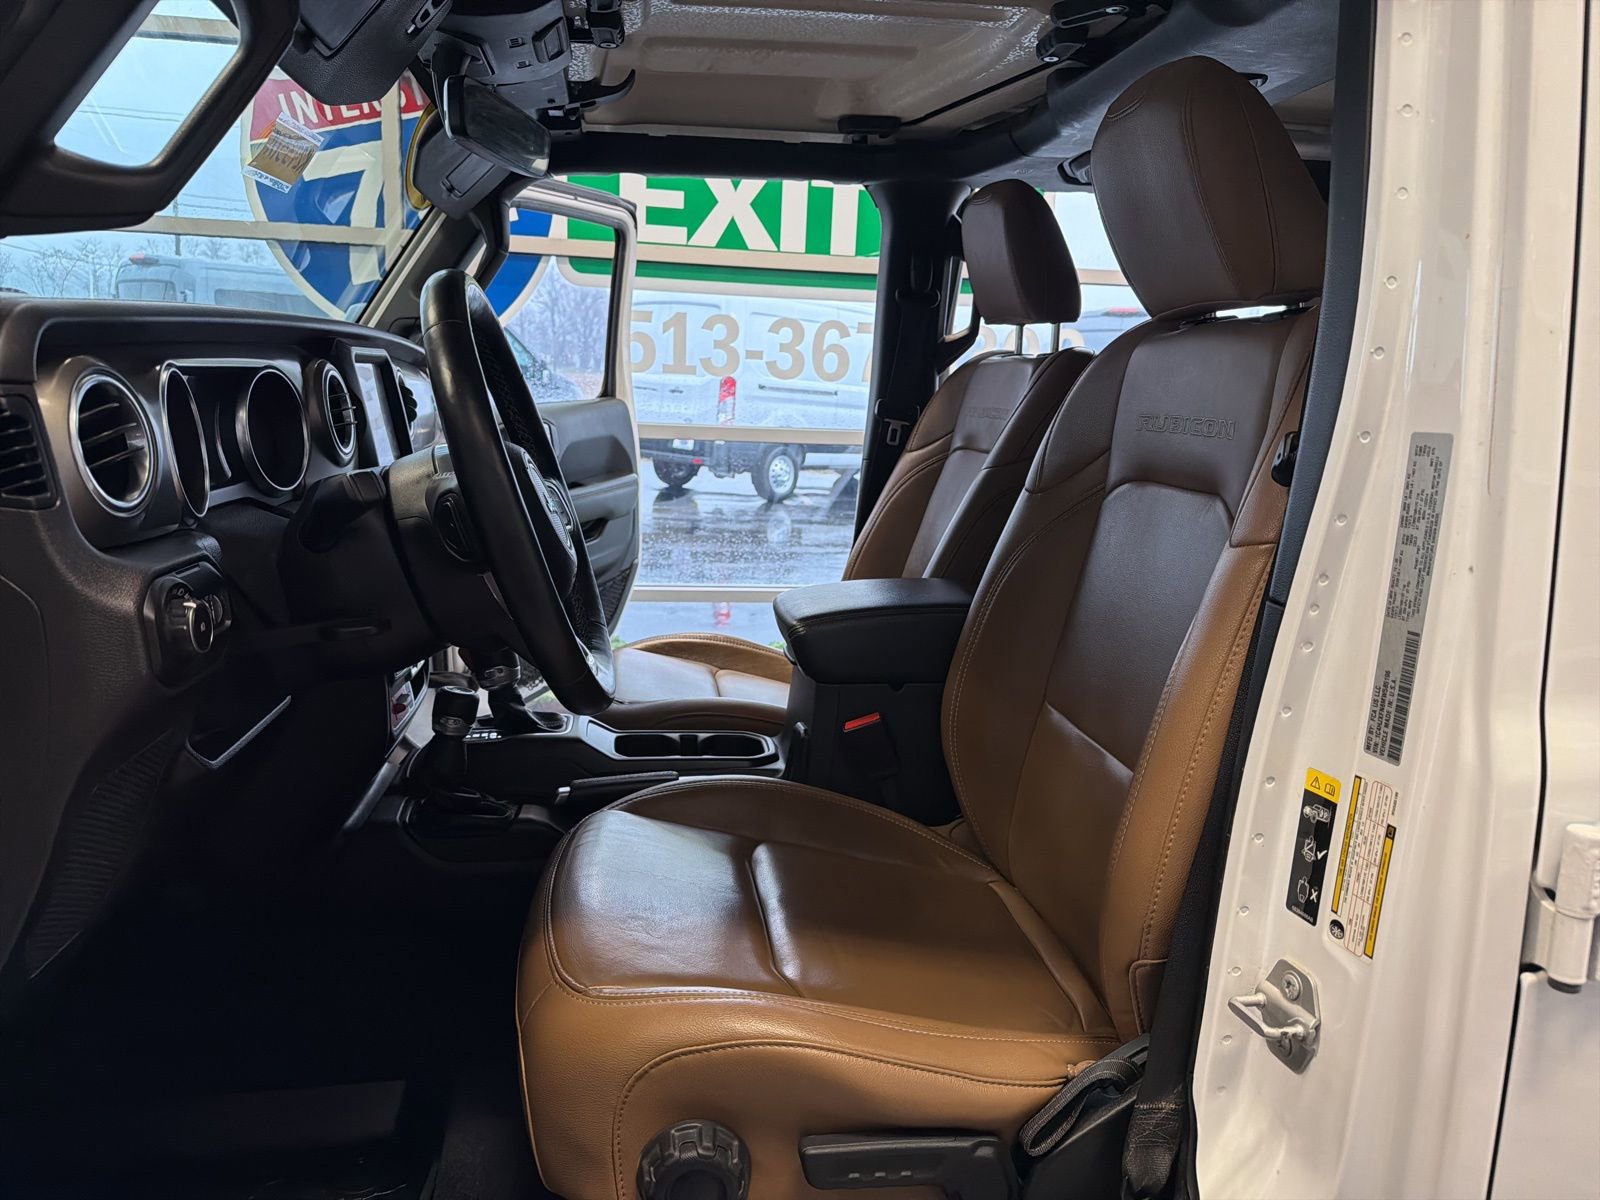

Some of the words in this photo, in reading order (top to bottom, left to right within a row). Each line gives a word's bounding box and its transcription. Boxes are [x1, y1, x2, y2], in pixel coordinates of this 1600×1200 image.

[619, 173, 868, 257] EXIT
[1136, 413, 1236, 441] RUBICON
[1383, 710, 1392, 728] MADE
[1379, 730, 1389, 756] VEHICLE
